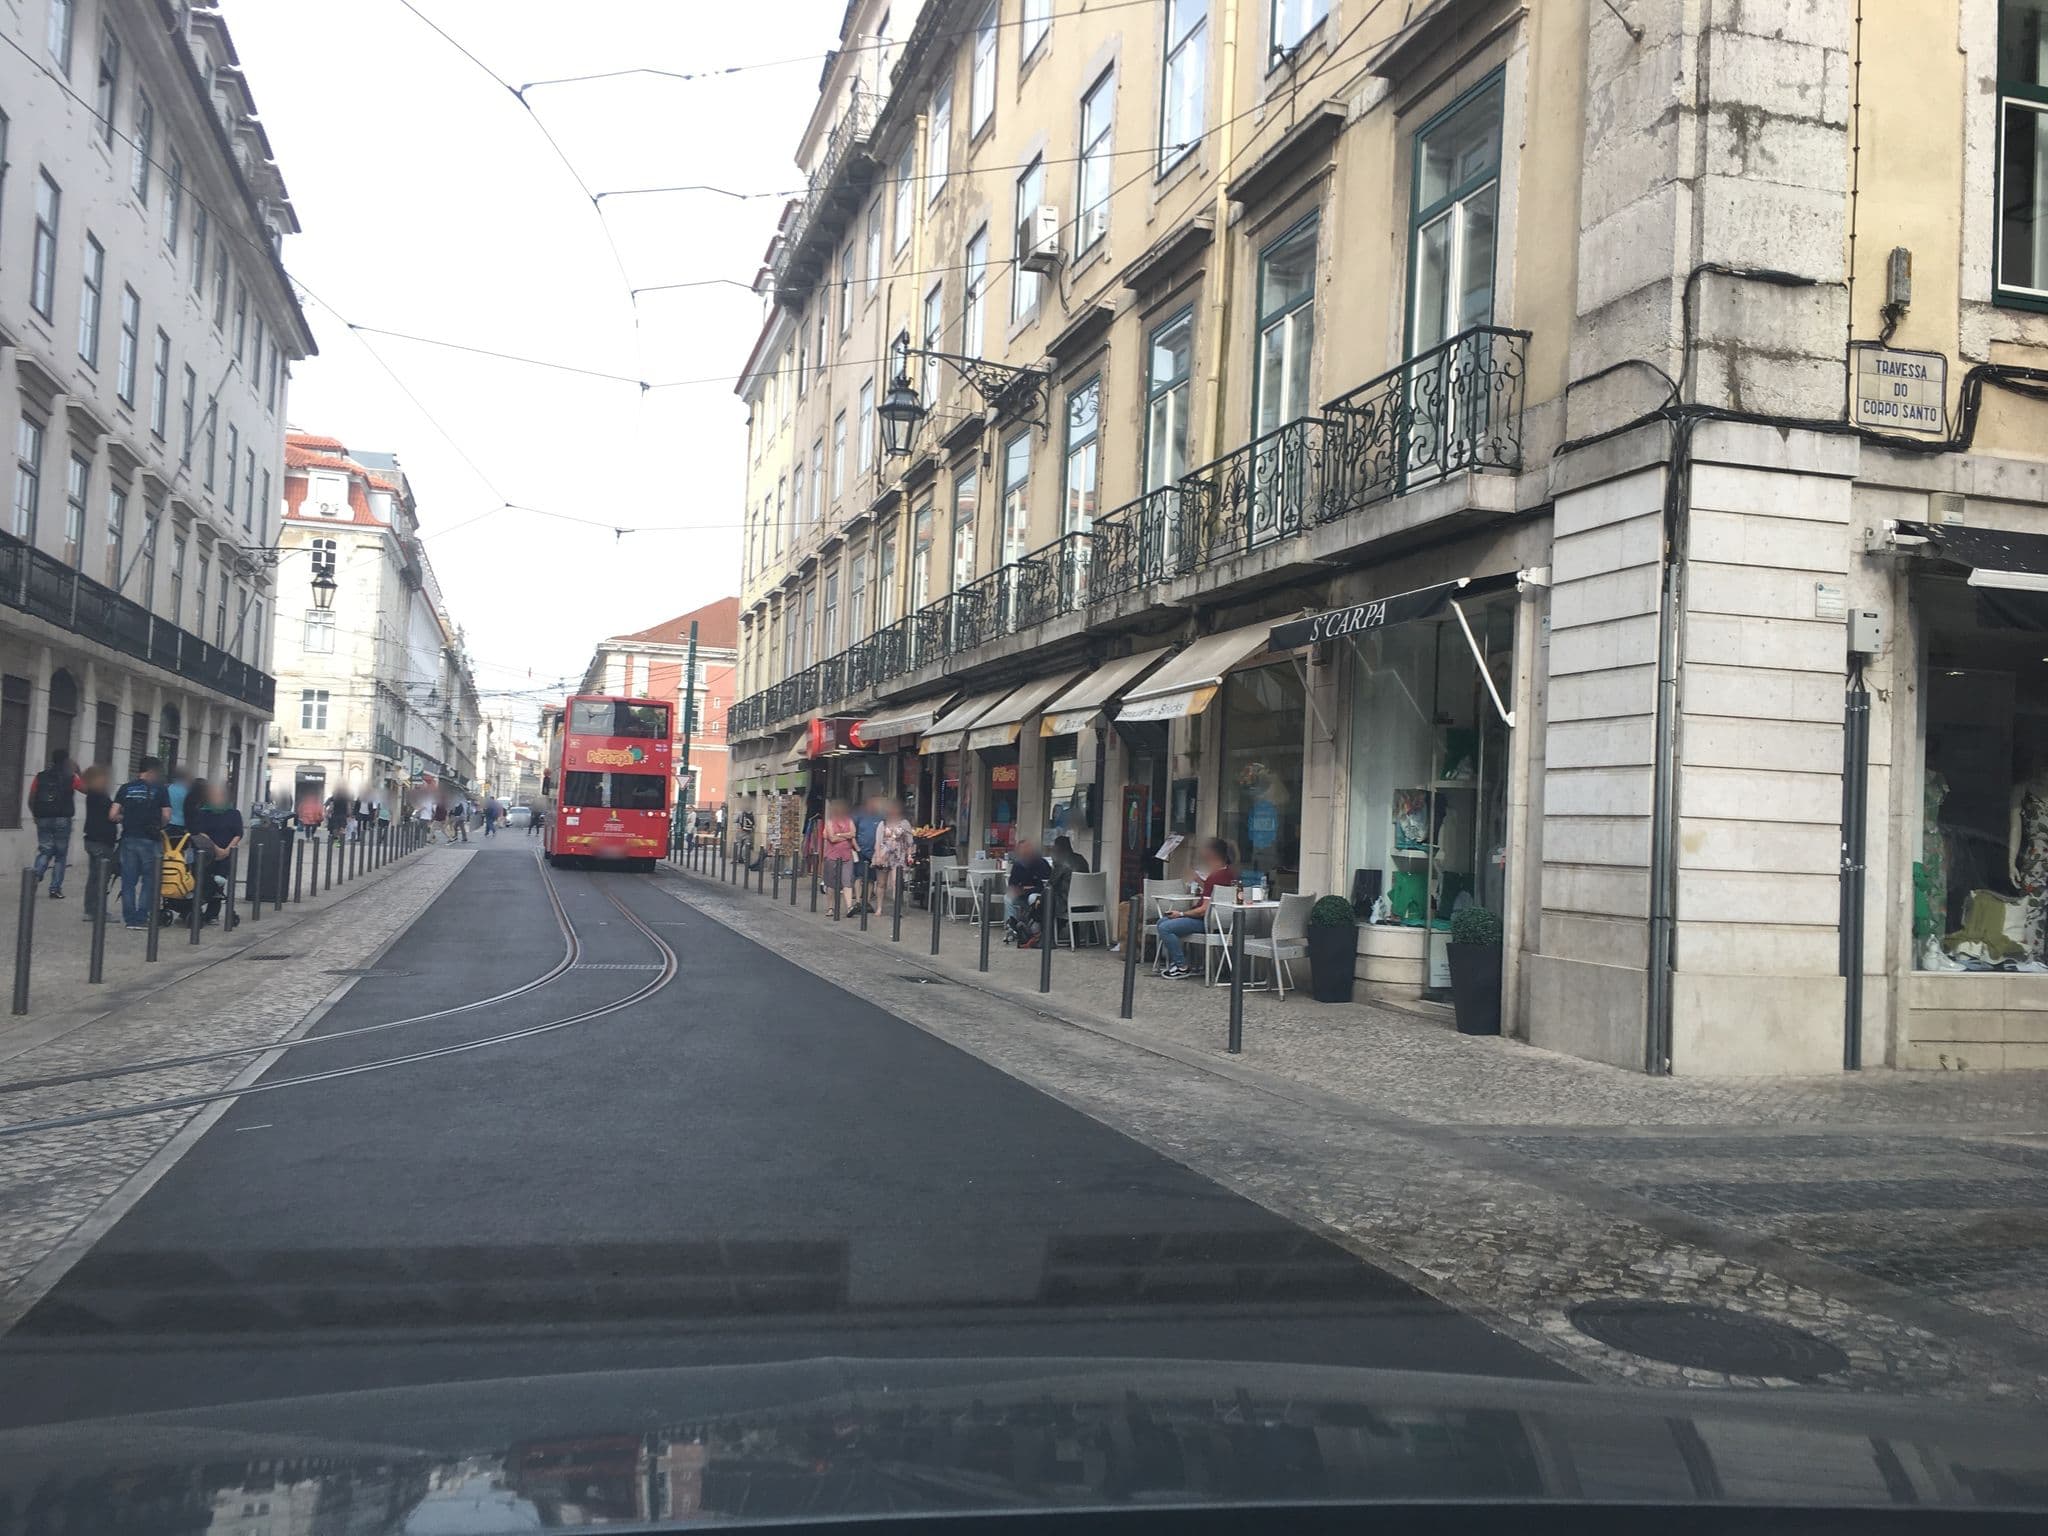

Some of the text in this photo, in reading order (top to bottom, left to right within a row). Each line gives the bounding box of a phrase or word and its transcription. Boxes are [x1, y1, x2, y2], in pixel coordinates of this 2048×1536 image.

[1876, 360, 1927, 379] TRAVESSA
[1894, 383, 1907, 397] DO
[1863, 400, 1936, 421] CORPO SANTO
